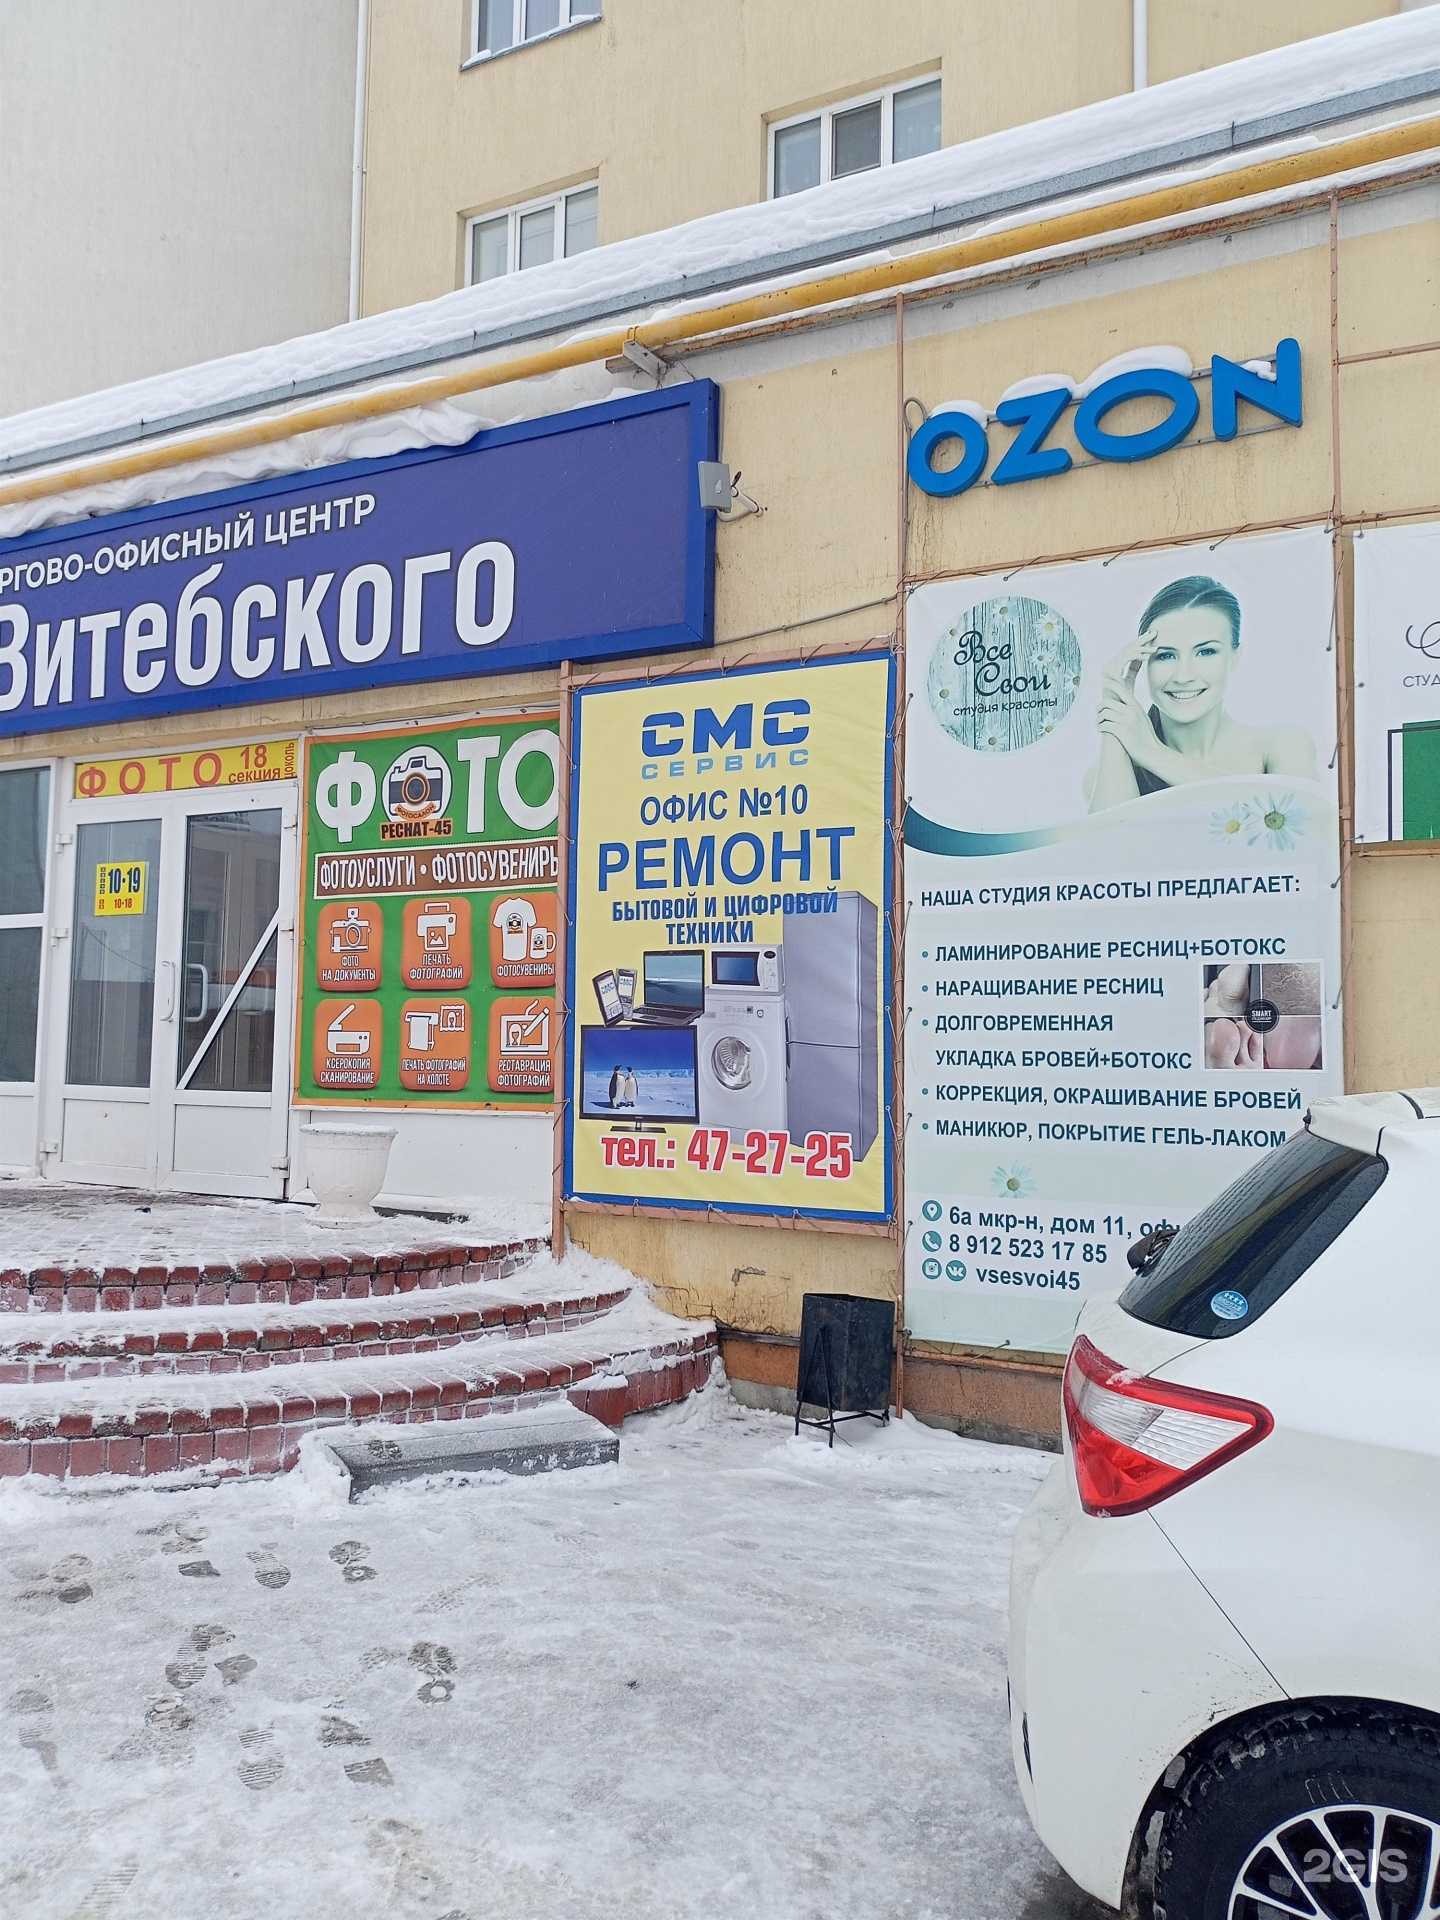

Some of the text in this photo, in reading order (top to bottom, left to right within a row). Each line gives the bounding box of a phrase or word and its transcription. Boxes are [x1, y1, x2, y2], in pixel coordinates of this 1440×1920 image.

[907, 337, 1303, 498] OZON
[264, 493, 376, 545] ЦЕНТР
[0, 541, 516, 712] Витебского
[954, 631, 1012, 665] Все
[975, 662, 1051, 697] Свои
[953, 697, 1058, 717] студия красоты
[641, 698, 811, 758] СМС
[78, 744, 267, 798] ФОТО 18
[228, 767, 281, 784] секция
[641, 749, 809, 780] СЕРВИС
[315, 728, 559, 843] ФОТО
[640, 784, 808, 825] ОФИС №10
[381, 820, 452, 840] РЕСНАТ-45
[320, 855, 416, 890] ФОТОУСЛУГИ
[598, 826, 856, 892] РЕМОНТ
[612, 886, 838, 921] БЫТОВОЙ И ЦИФРОВОЙ
[921, 875, 1300, 907] НАША СТУДИЯ КРАСОТЫ ПРЕДЛАГАЕТ:
[665, 920, 753, 945] ТЕХНИКИ
[341, 955, 360, 967] ФОТО
[422, 953, 452, 965] ПЕЧАТЬ
[935, 937, 1286, 962] ЛАМИНИРОВАНИЕ РЕСНИЦ+БОТОКС
[322, 969, 376, 981] НА ДОКУМЕНТЫ
[409, 965, 464, 980] ФОТОГРАФИЙ
[935, 977, 1164, 998] НАРАЩИВАНИЕ РЕСНИЦ
[935, 1015, 1113, 1034] ДОЛГОВРЕМЕННАЯ
[935, 1047, 1192, 1070] УКЛАДКА БРОВЕЙ+БОТОКС
[497, 1072, 550, 1087] ФОТОГРАФИЙ
[935, 1085, 1301, 1110] КОРРЕКЦИЯ, ОКРАШИВАНИЕ БРОВЕЙ
[935, 1120, 1286, 1149] МАНИКЮР, ПОКРЫТИЕ ГЕЛЬ-ЛАКОМ
[601, 1129, 851, 1178] тел.: 47-27-25
[950, 1206, 972, 1225] 6а
[979, 1211, 1044, 1233] мкр-н,
[1050, 1216, 1096, 1235] дом
[1103, 1215, 1132, 1239] 11,
[949, 1234, 1107, 1264] 8 912 523 17 85
[976, 1268, 1081, 1291] vsesvoi45
